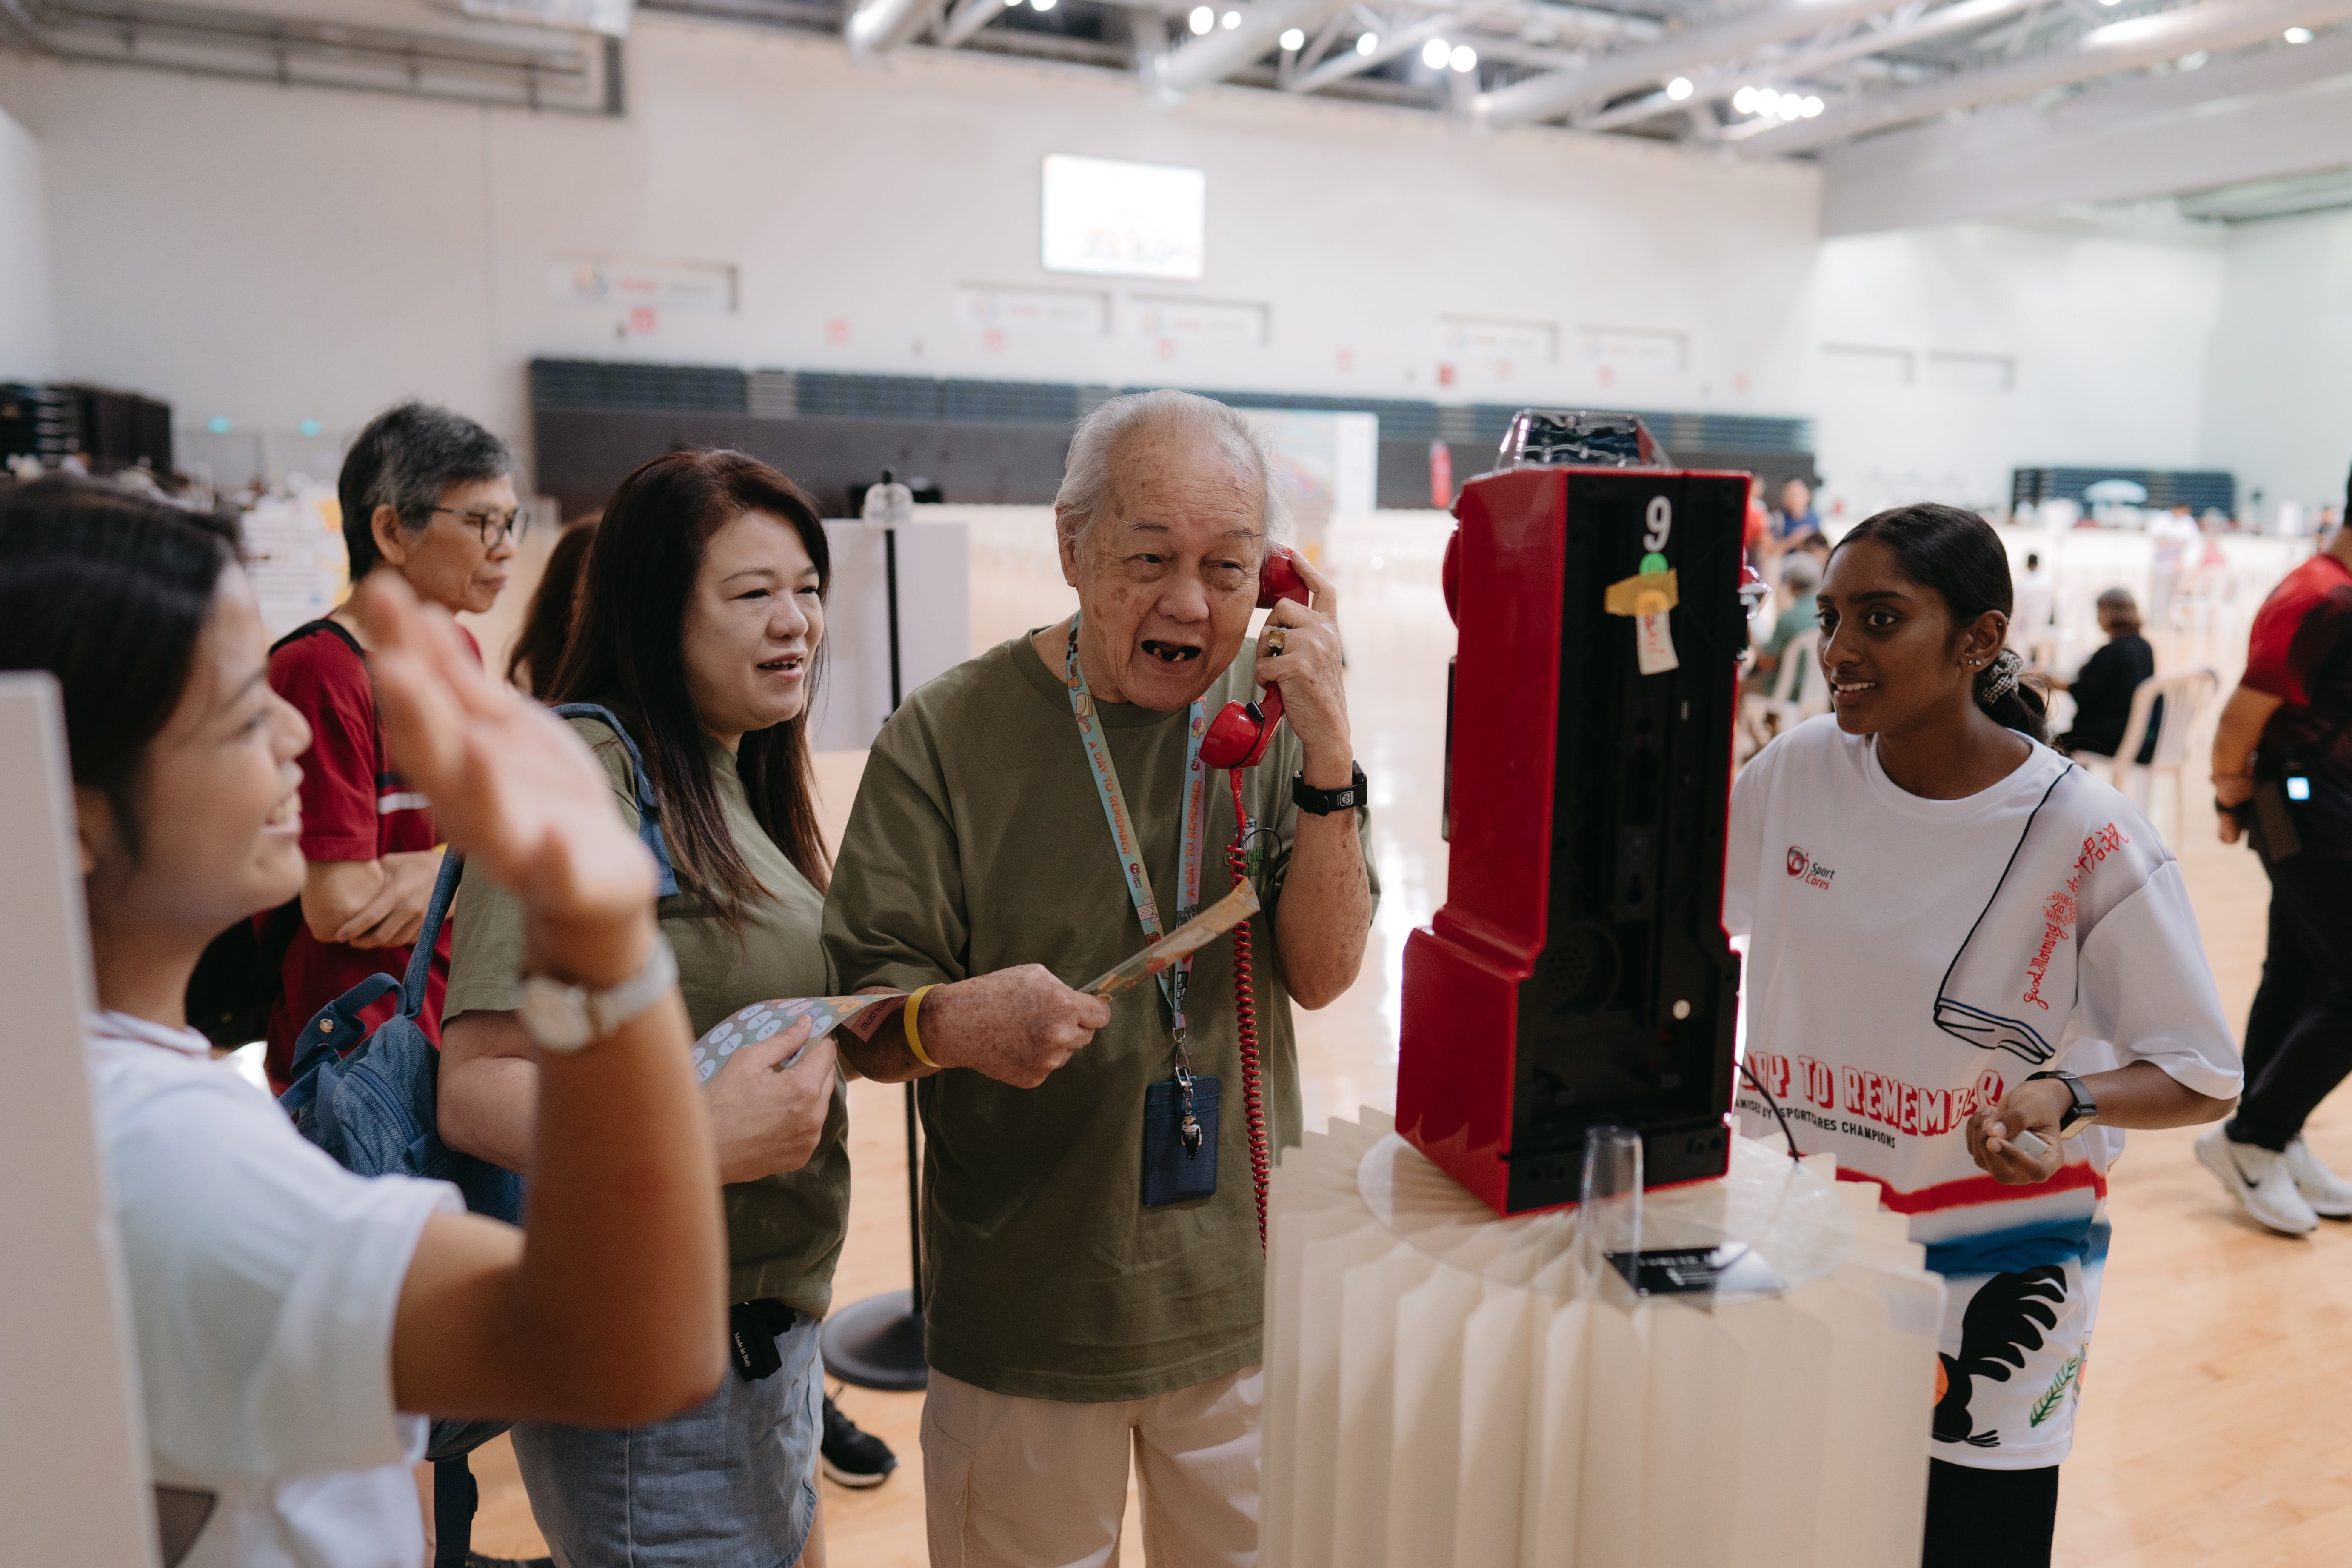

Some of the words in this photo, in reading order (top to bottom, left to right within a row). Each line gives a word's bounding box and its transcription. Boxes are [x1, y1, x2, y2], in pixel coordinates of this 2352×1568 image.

[1643, 494, 1672, 552] 9
[1088, 742, 1098, 750] A
[1093, 751, 1109, 774] DAY
[1103, 776, 1115, 792] TO
[1186, 780, 1202, 840] REMEMBER
[1108, 795, 1131, 855] REMEMBER
[1185, 842, 1195, 858] TO
[1185, 861, 1195, 885] DAY
[1811, 862, 1835, 880] Sport
[1805, 873, 1830, 890] Cares
[1185, 888, 1195, 897] A
[860, 1011, 877, 1031] COLLECT
[1798, 1055, 1834, 1109] TO
[1762, 1107, 1773, 1120] BY
[1842, 1122, 1895, 1148] CHAMPIONS
[734, 1332, 743, 1348] Made
